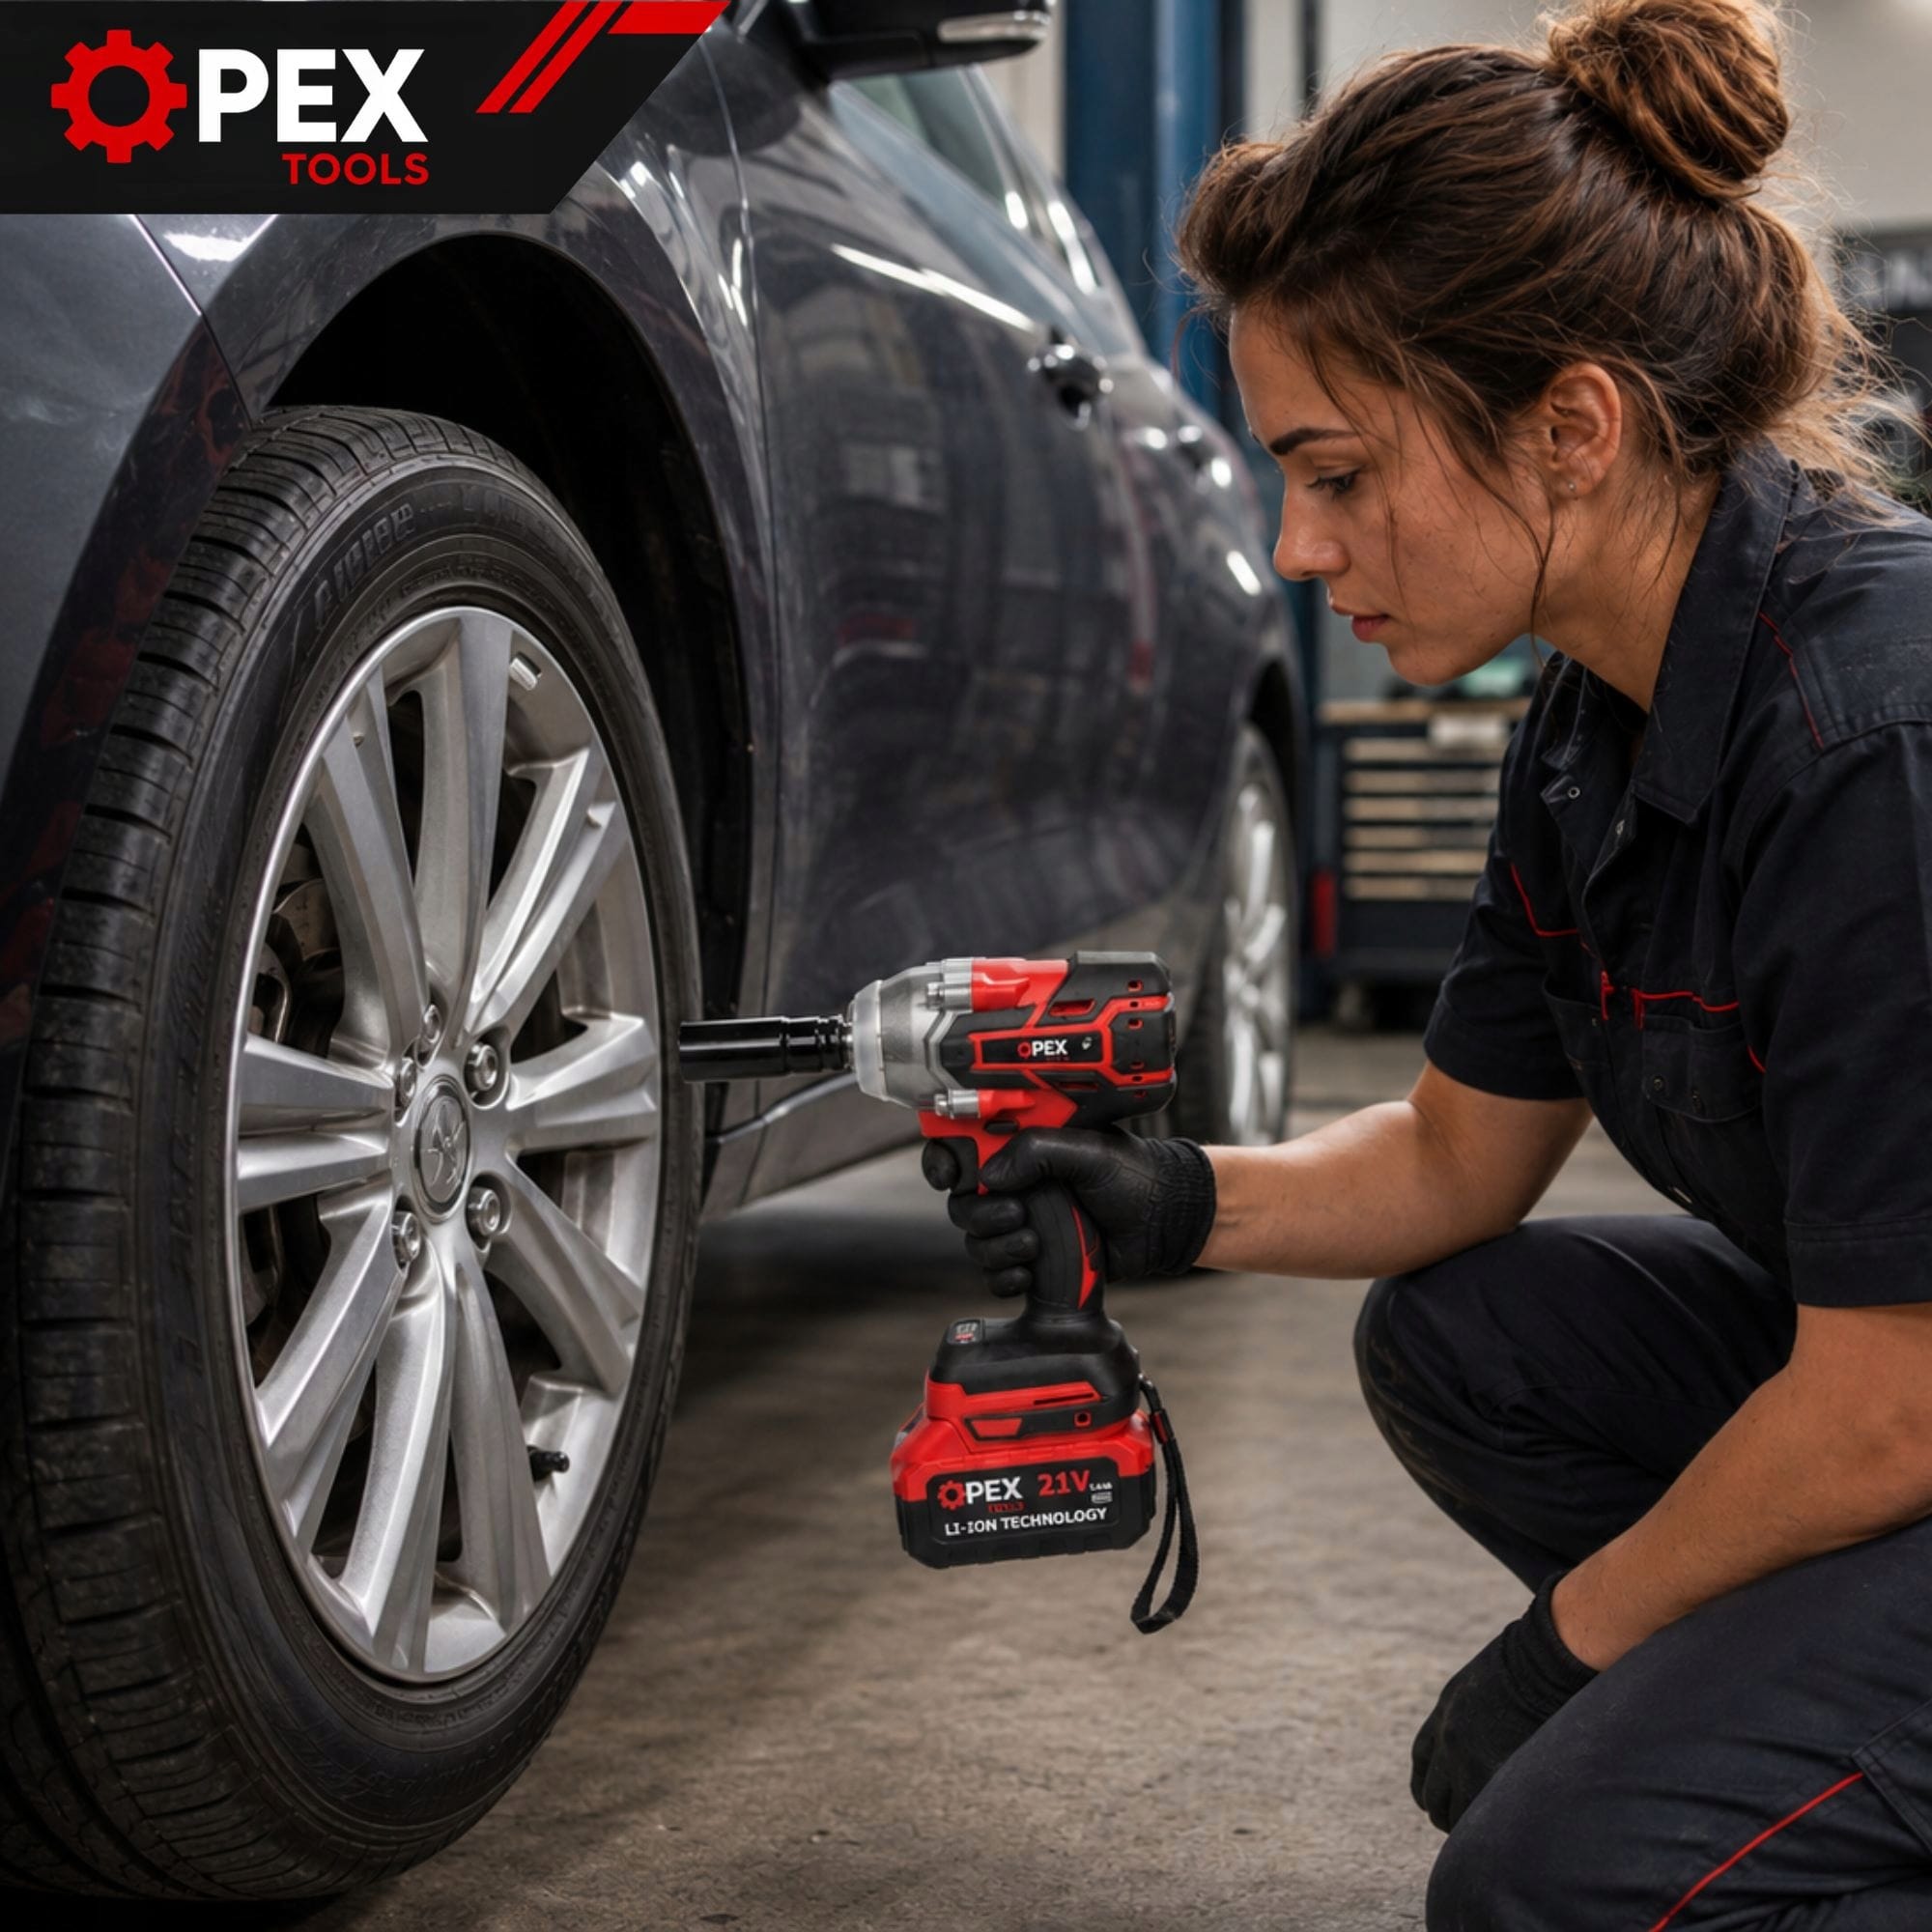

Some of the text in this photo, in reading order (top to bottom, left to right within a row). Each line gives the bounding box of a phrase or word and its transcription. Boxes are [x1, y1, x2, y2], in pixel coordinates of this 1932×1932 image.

[1037, 1469, 1090, 1496] 21V
[945, 1519, 997, 1536] LI-ION
[1000, 1507, 1107, 1529] TECHNOLOGY
